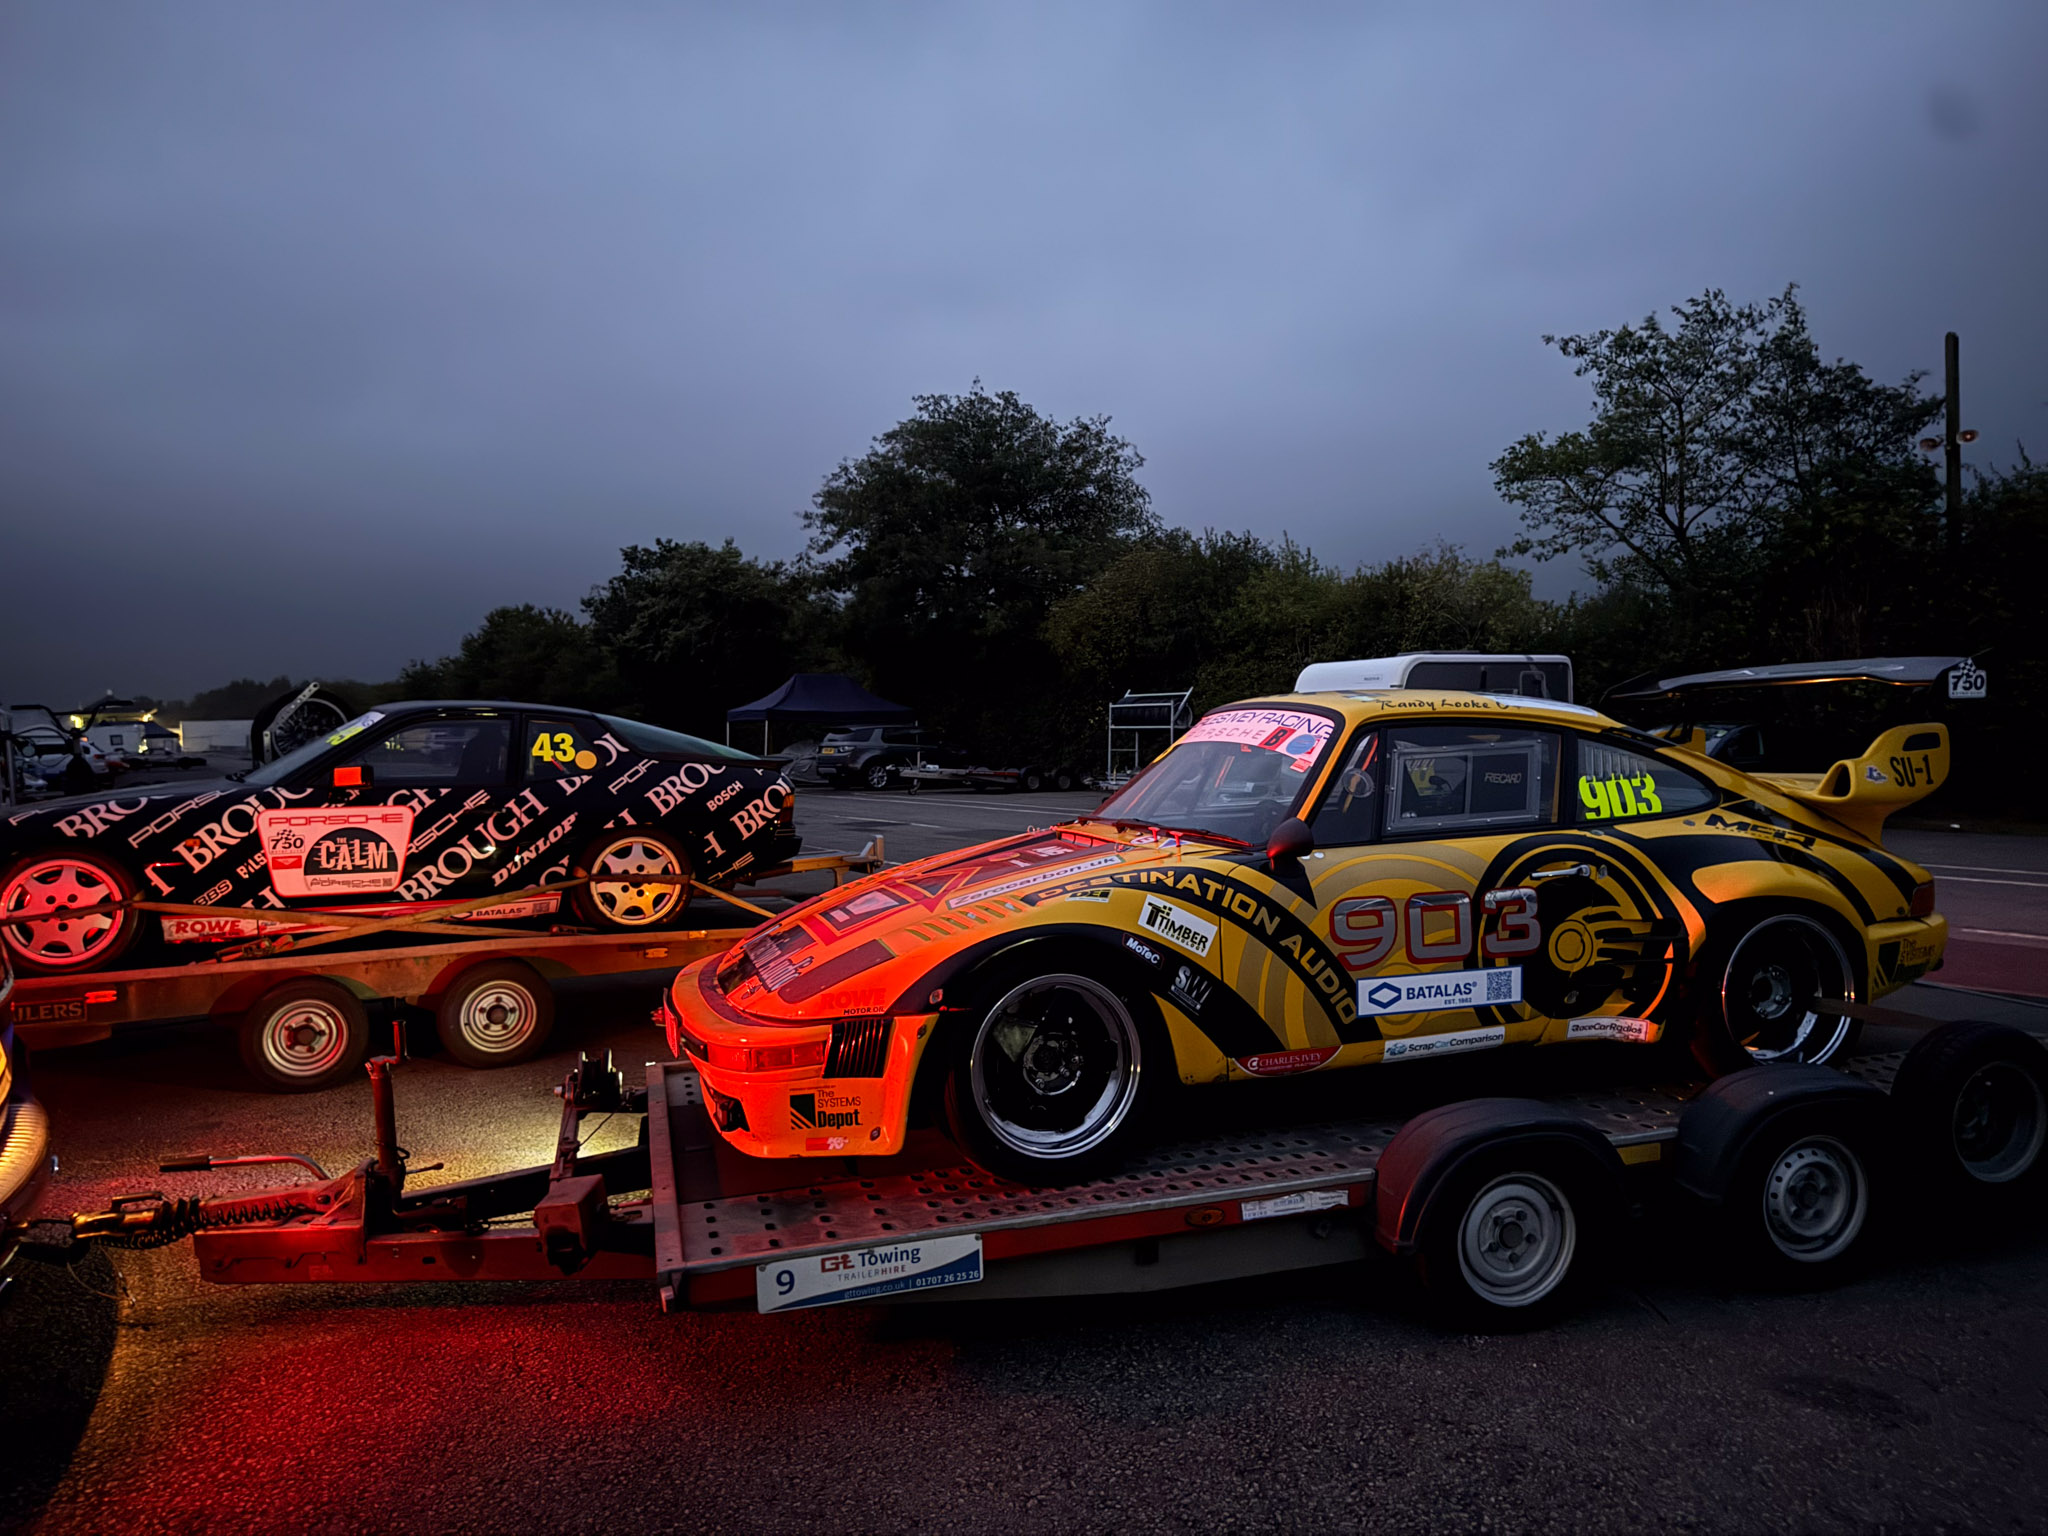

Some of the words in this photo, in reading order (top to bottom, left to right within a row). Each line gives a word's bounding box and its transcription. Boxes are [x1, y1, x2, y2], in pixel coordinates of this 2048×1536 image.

[1951, 674, 1985, 691] 750
[1257, 712, 1335, 740] RACING
[1265, 729, 1287, 747] B
[531, 732, 576, 763] 43
[1890, 754, 1934, 788] SU-1
[705, 779, 745, 812] BOSCH
[1578, 770, 1663, 820] 903
[268, 813, 404, 827] PORSCHE
[270, 836, 304, 850] 750
[318, 839, 389, 872] CALM
[393, 786, 550, 902] BROUGH
[491, 812, 578, 888] DUNLOP
[174, 920, 242, 935] ROWE
[1159, 914, 1209, 949] TIMBER
[1329, 886, 1542, 972] 903
[1036, 870, 1281, 936] DESTINATION
[1279, 935, 1357, 1025] AUDIO
[1126, 937, 1161, 964] MoTeC
[13, 1001, 84, 1022] ILERS
[820, 988, 887, 1010] ROWE
[843, 1006, 872, 1015] MOTOR
[1259, 1056, 1300, 1067] CHARLES
[1301, 1052, 1322, 1063] IVEY
[816, 1089, 835, 1098] The
[817, 1095, 862, 1109] SYSTEMS
[857, 1246, 921, 1268] Towing
[775, 1269, 796, 1296] 9
[843, 1281, 906, 1300] gttowing.co.uk
[915, 1274, 942, 1287] 01707
[943, 1273, 955, 1284] 26
[956, 1271, 968, 1281] 25
[968, 1270, 980, 1280] 26
